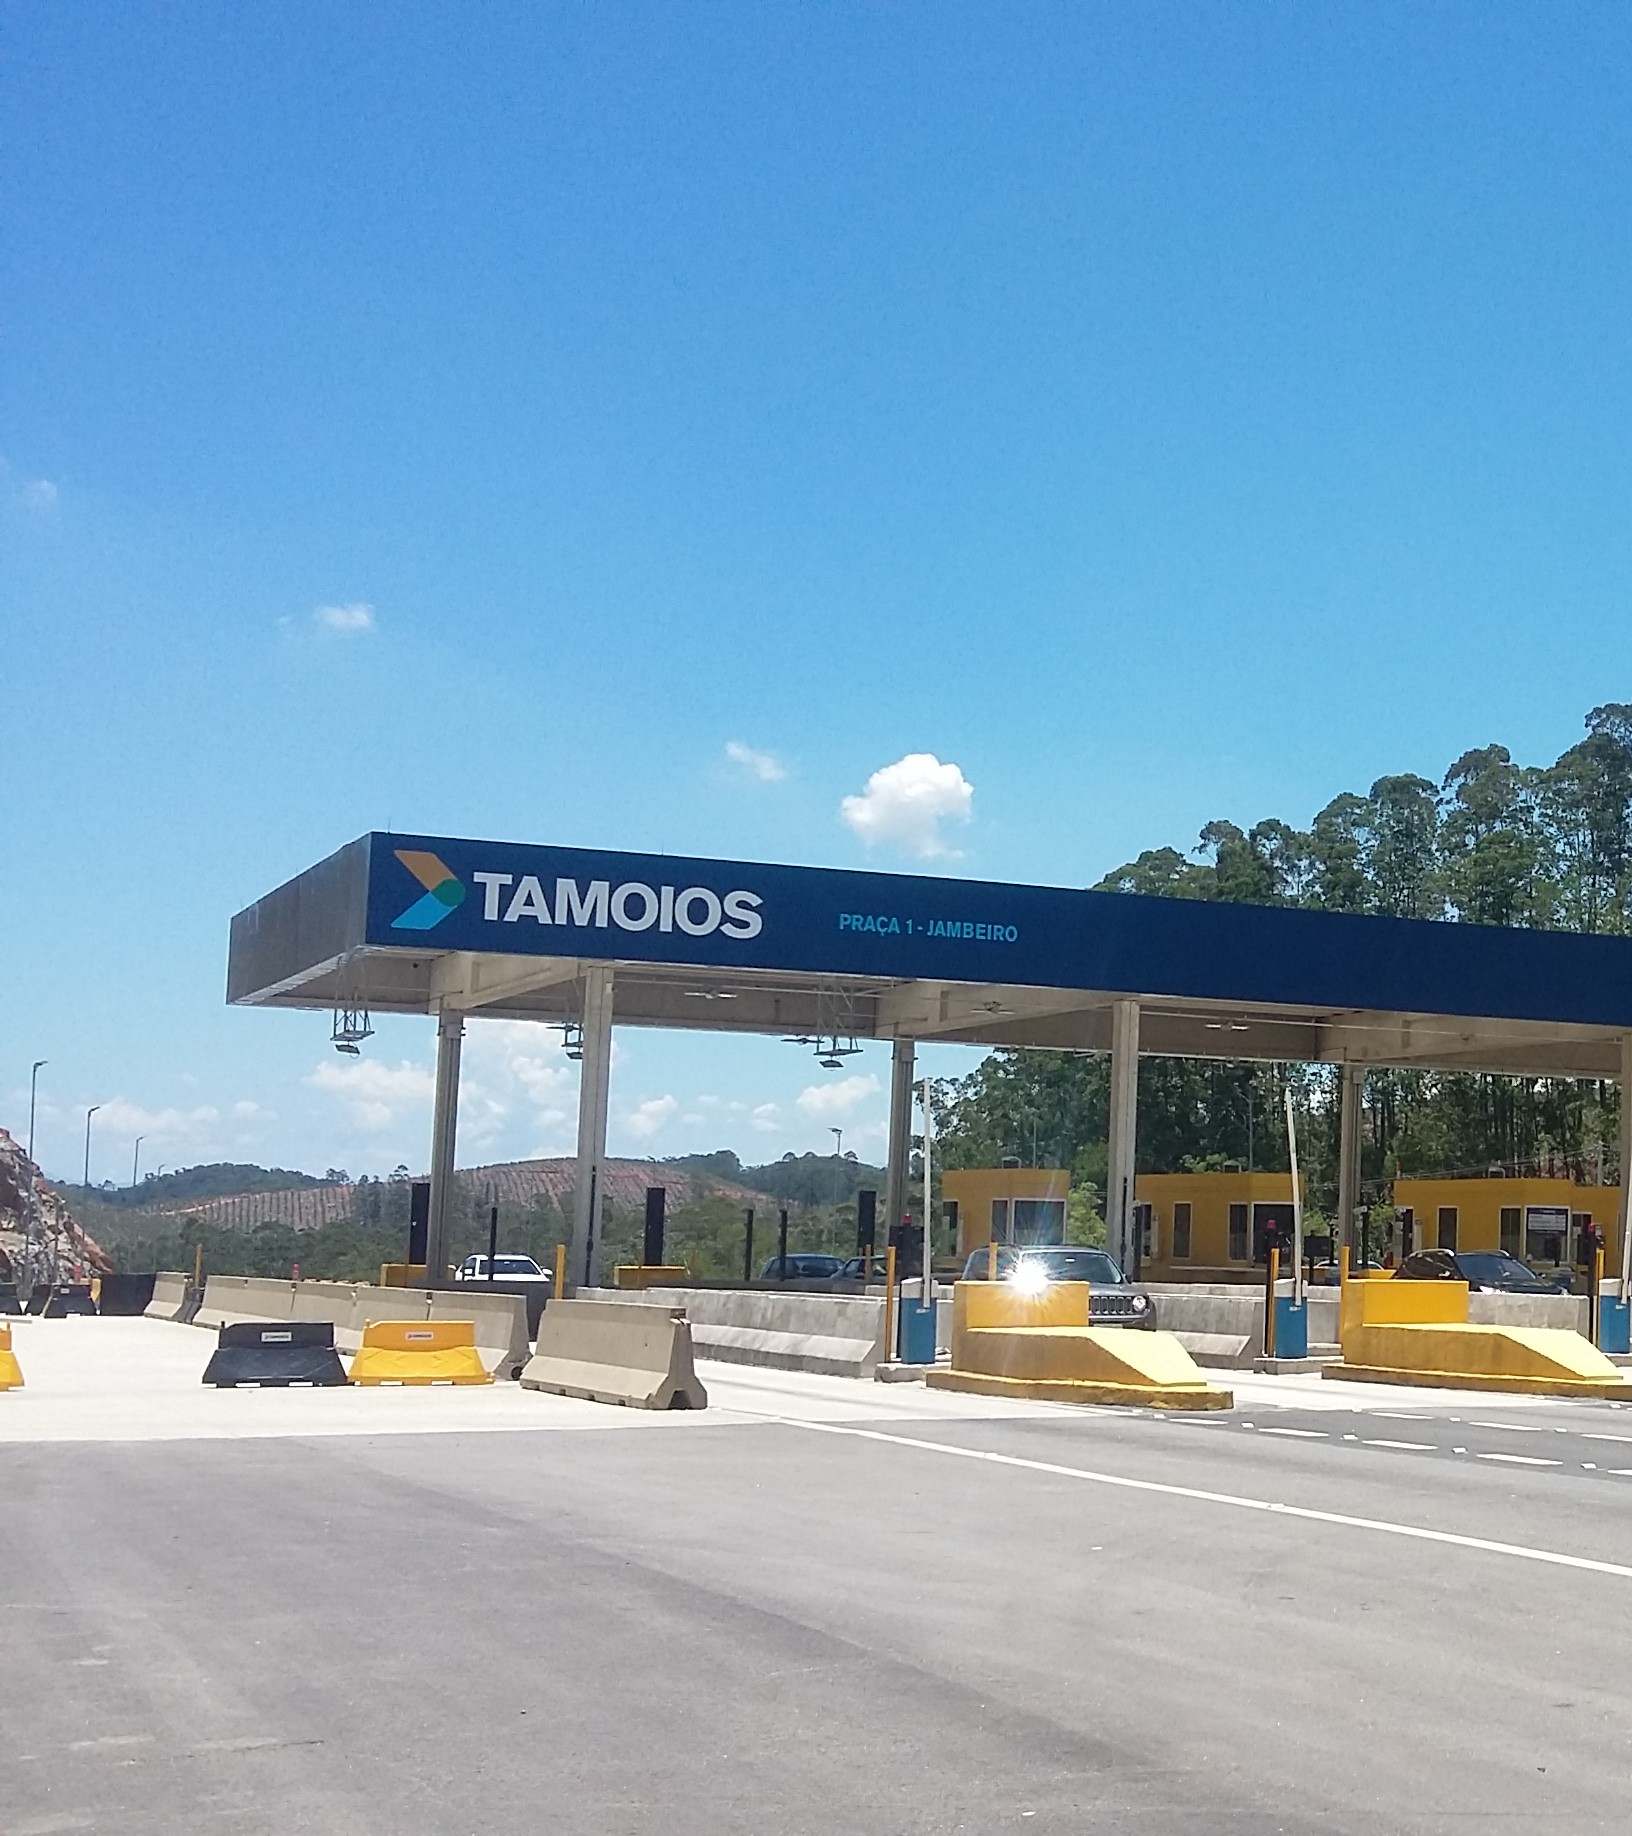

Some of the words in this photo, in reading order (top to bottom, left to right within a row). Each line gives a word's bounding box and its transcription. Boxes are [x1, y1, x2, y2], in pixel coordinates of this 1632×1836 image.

[473, 871, 764, 939] TAMOIOS
[839, 913, 901, 937] PRAÇA
[905, 919, 913, 935] 1
[926, 919, 1019, 943] JAMBEIRO
